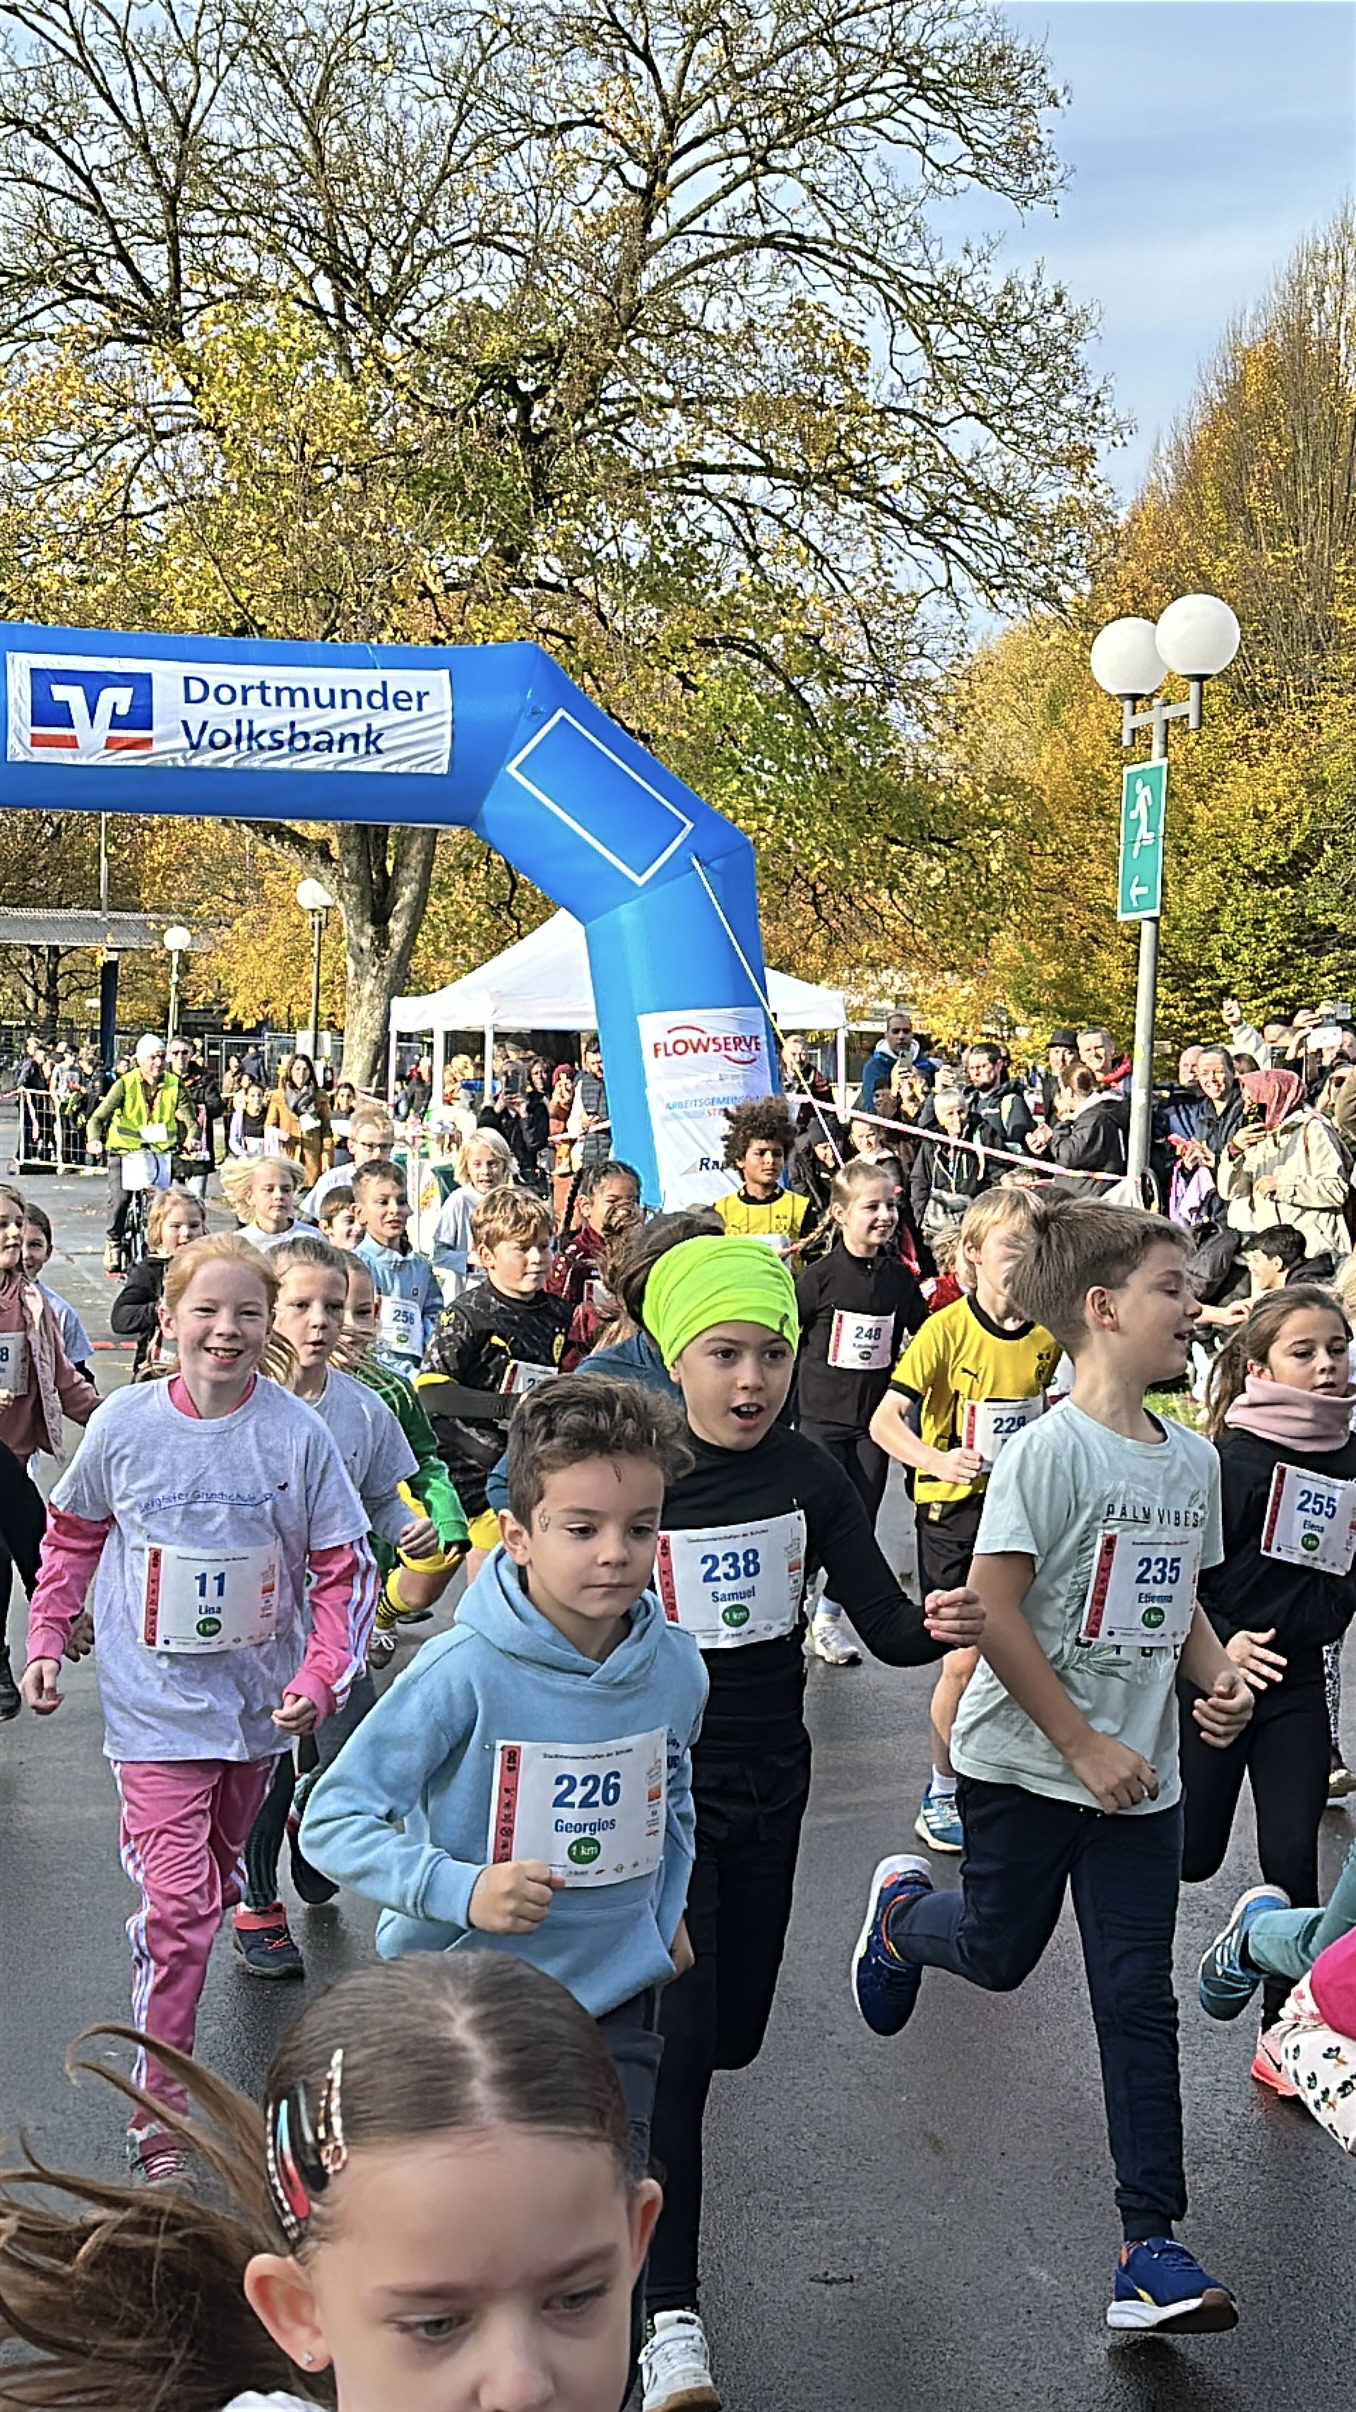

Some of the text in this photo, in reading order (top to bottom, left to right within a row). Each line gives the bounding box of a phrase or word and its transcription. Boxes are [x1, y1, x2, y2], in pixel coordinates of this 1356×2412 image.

[182, 675, 430, 711] Dortmunder
[182, 719, 385, 755] Volksbank
[653, 1035, 761, 1058] FLOWSERVE
[854, 1326, 882, 1341] 248
[1106, 1504, 1199, 1528] PALM VIBES
[1296, 1489, 1337, 1520] 255
[700, 1548, 761, 1583] 238
[1135, 1557, 1181, 1584] 235
[195, 1571, 226, 1598] 11
[711, 1586, 756, 1603] Samuel
[732, 1611, 748, 1620] km
[552, 1771, 621, 1809] 226
[554, 1818, 616, 1836] Georgios
[580, 1845, 598, 1856] km
